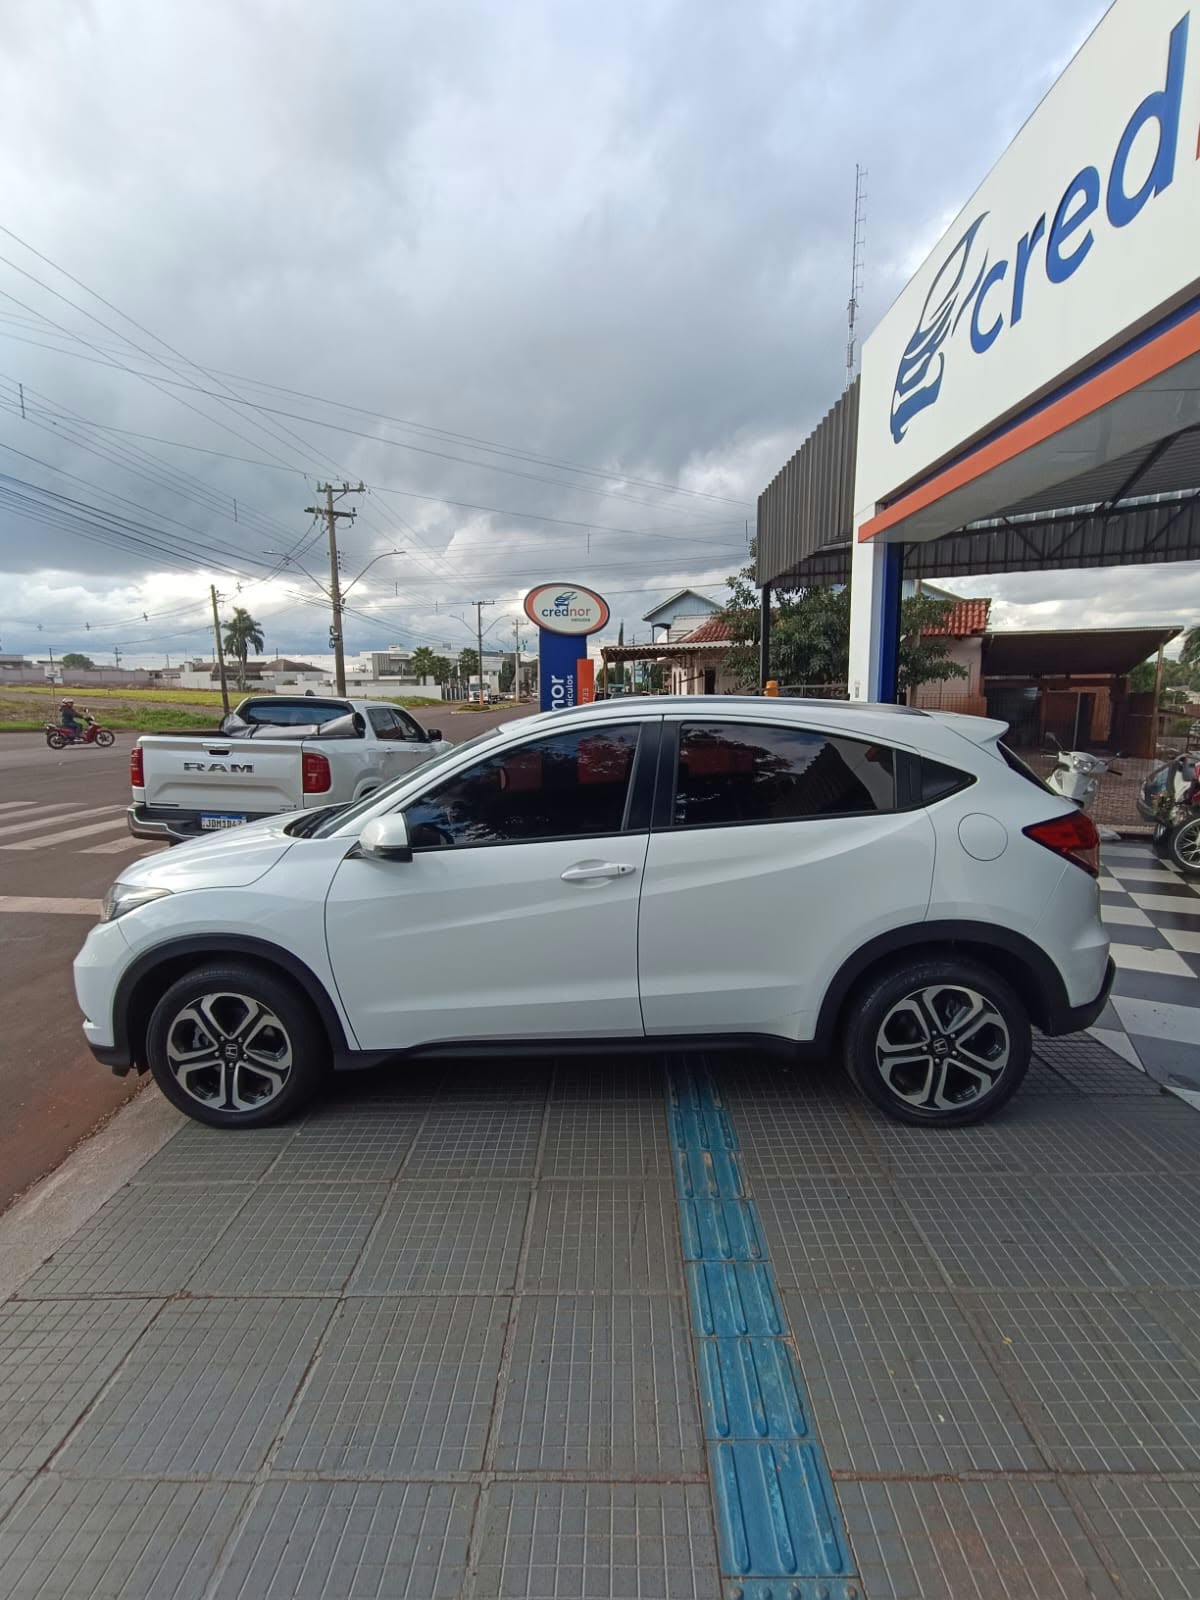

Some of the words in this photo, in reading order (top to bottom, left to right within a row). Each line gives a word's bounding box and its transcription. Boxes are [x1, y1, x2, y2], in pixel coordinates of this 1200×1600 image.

[970, 11, 1200, 355] cred
[541, 606, 591, 617] crednor
[183, 762, 254, 773] RAM
